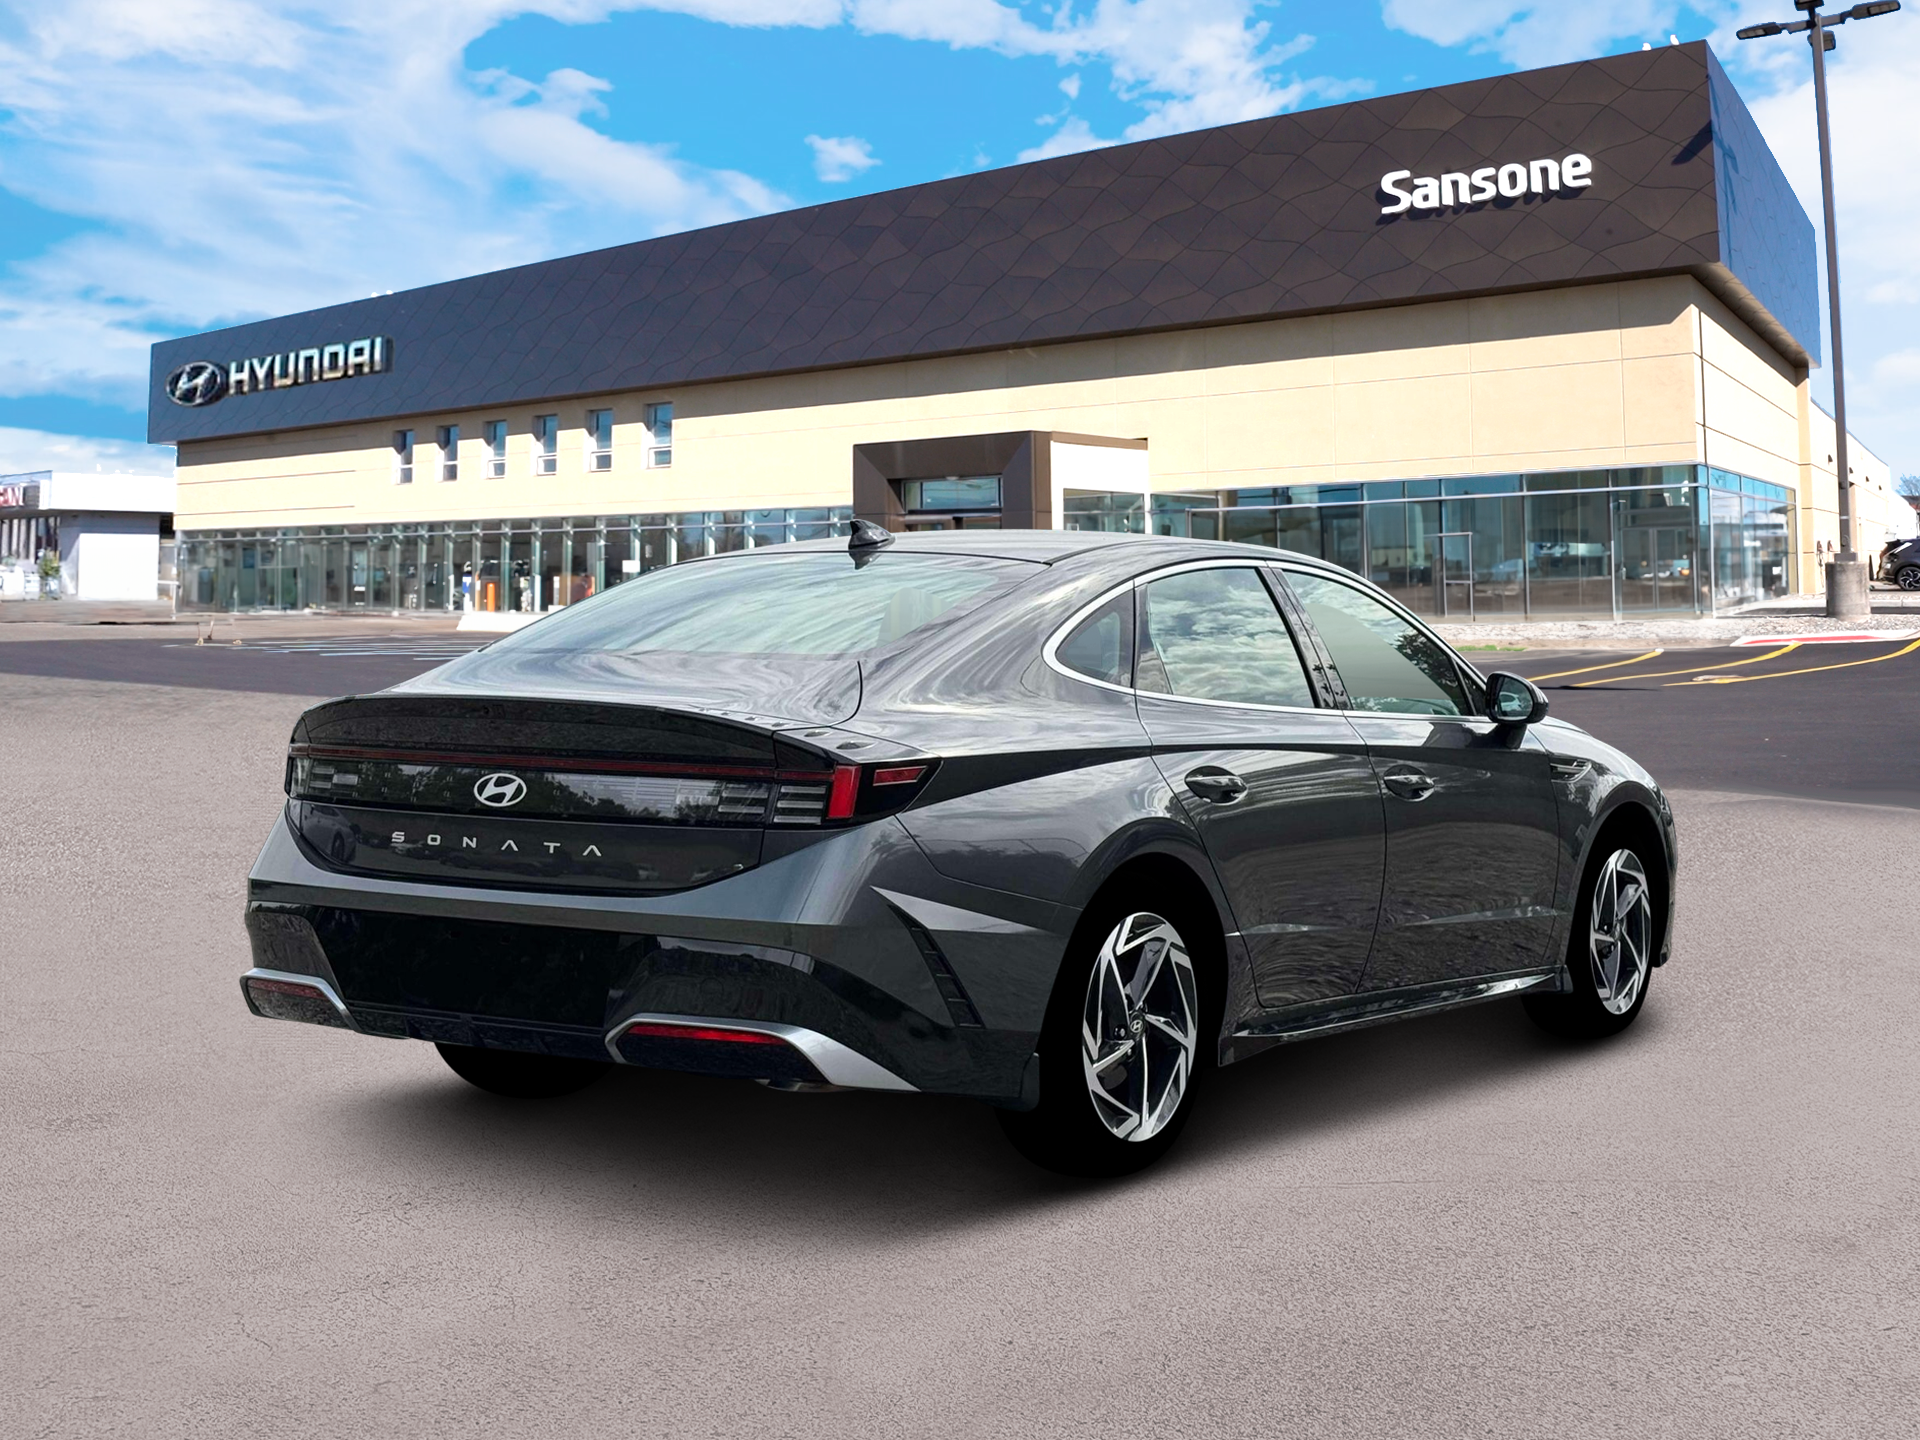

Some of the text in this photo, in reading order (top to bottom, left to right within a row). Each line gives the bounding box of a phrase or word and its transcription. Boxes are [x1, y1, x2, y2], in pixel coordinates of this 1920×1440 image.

[1380, 153, 1593, 214] Sansone
[229, 336, 384, 396] HYUNDAI
[390, 830, 603, 857] SONATA
